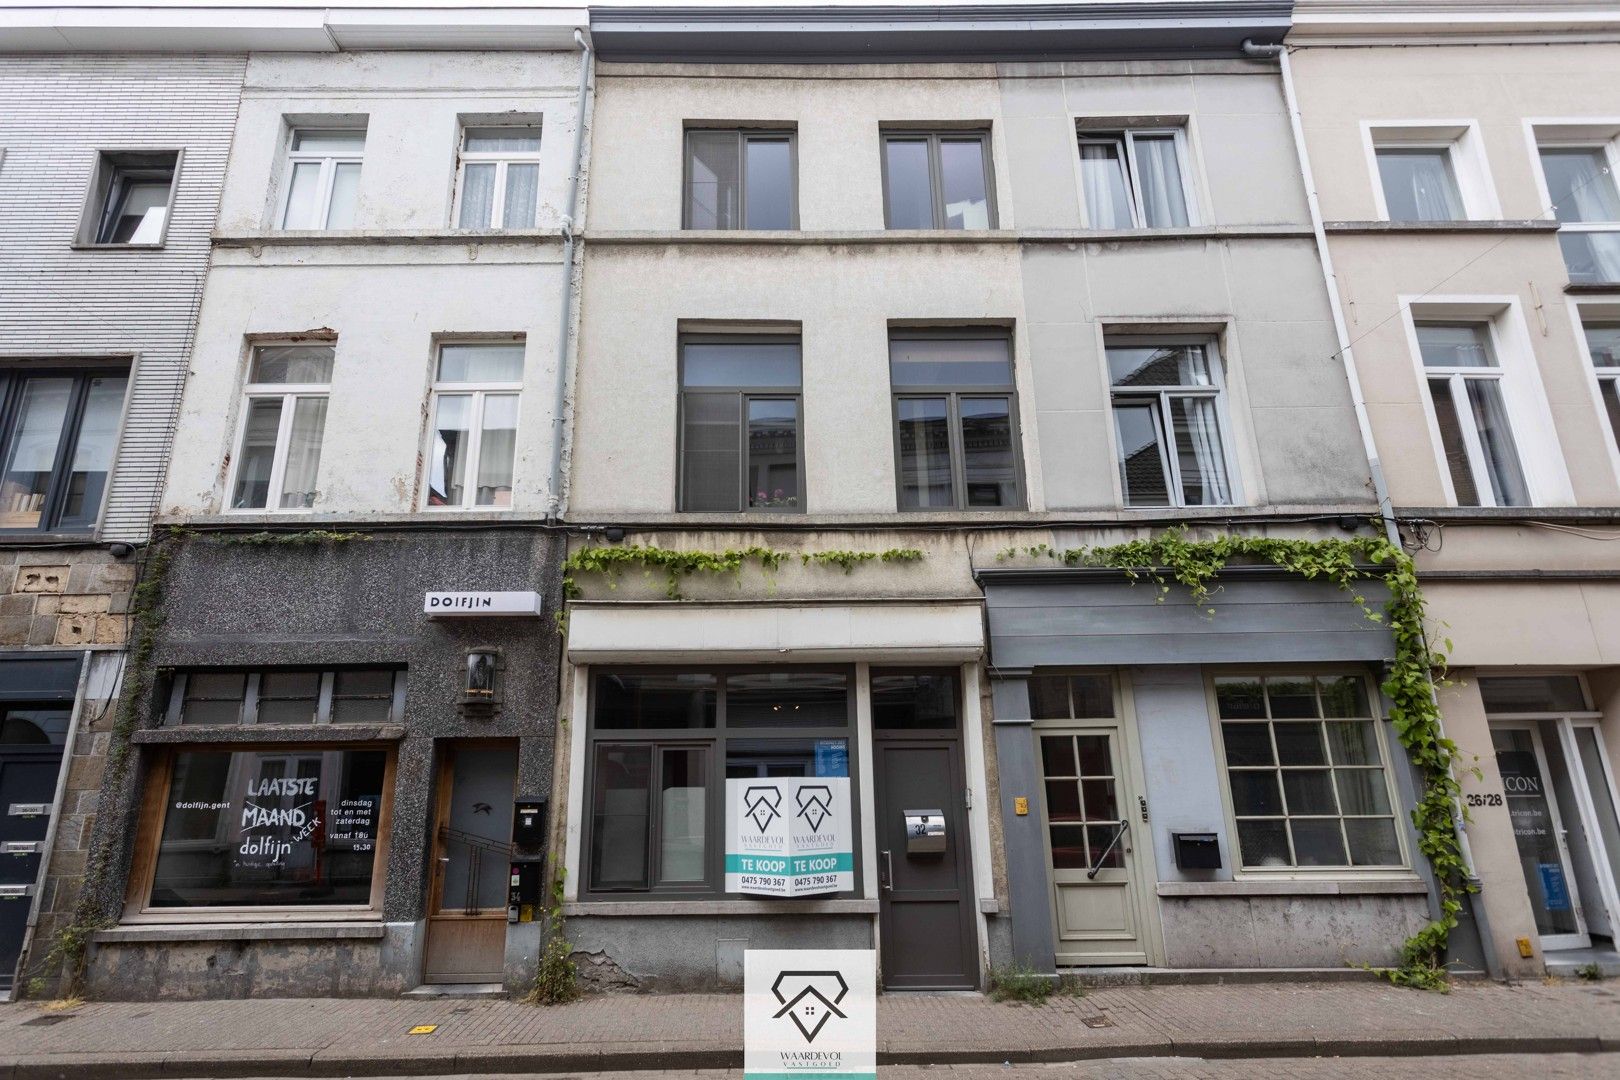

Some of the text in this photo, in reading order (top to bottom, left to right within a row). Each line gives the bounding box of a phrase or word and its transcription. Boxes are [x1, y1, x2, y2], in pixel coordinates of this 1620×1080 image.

[247, 777, 318, 797] LAATSTE
[175, 801, 230, 810] @dolfijn.gent
[341, 799, 373, 808] dinsdag
[1466, 793, 1503, 807] 26/28
[241, 807, 306, 828] MAAND
[330, 808, 342, 816] tot
[356, 808, 372, 816] met
[335, 817, 371, 826] zaterdag
[292, 816, 322, 842] WEEK
[329, 831, 352, 839] vanaf
[915, 823, 927, 835] 32
[1514, 828, 1546, 836] tricon.be
[741, 858, 786, 872] TE KOOP
[793, 857, 837, 872] TE KOOP
[741, 876, 786, 887] 0475 790 367
[794, 874, 837, 887] 0475 790 367
